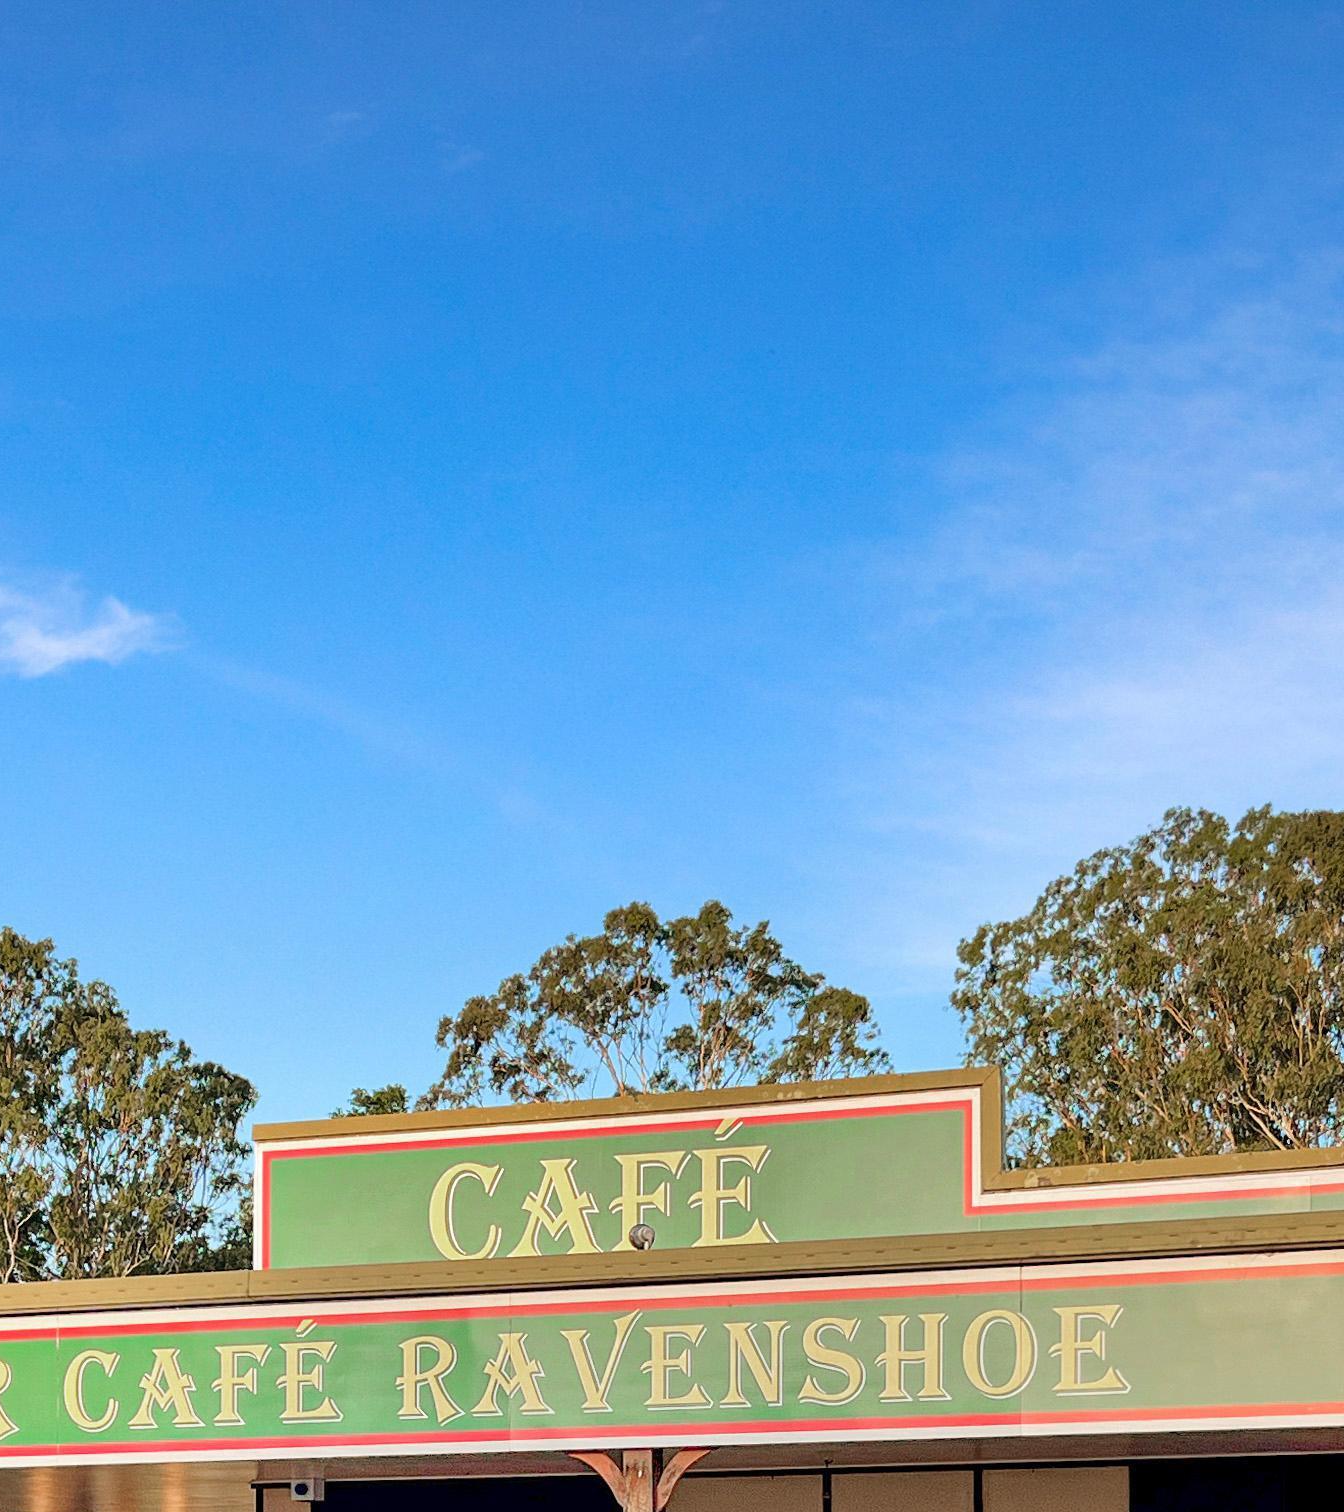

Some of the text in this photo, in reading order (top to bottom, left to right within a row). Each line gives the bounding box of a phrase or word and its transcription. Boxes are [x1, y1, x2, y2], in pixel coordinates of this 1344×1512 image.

[429, 1118, 780, 1260] CAFÉ
[63, 1319, 344, 1433] CAFÉ
[395, 1303, 1132, 1427] RAVENSHOE
